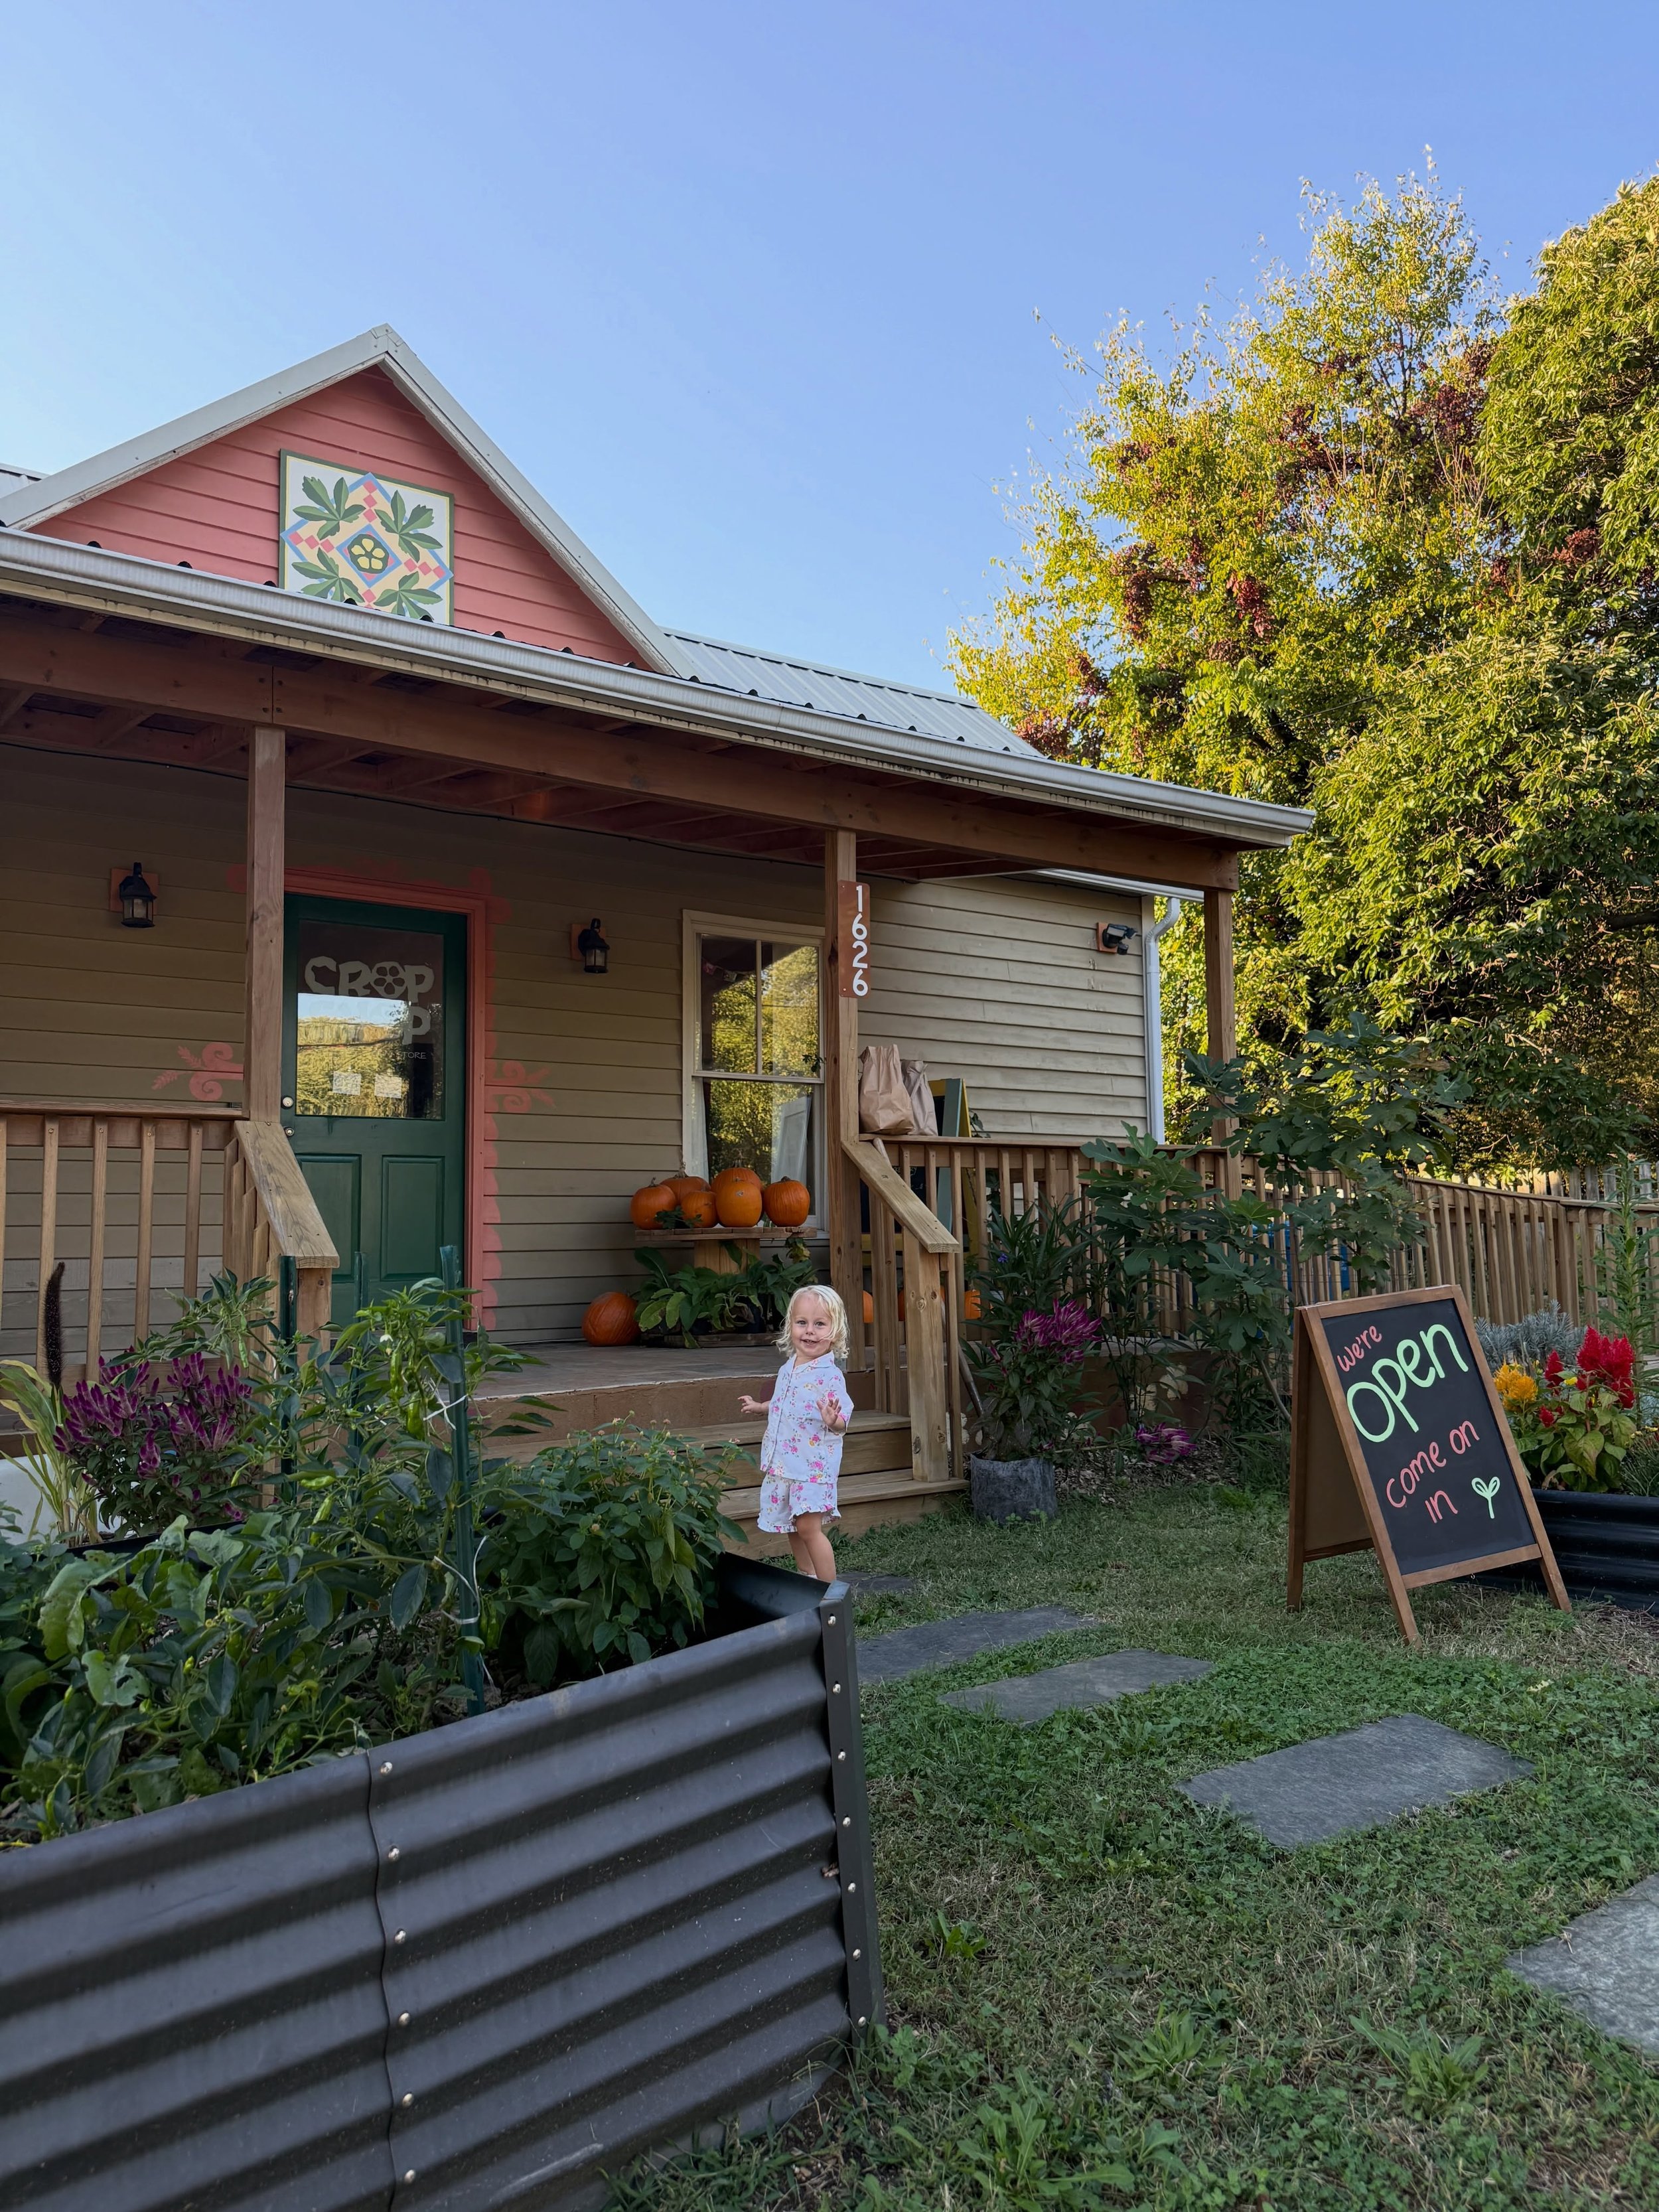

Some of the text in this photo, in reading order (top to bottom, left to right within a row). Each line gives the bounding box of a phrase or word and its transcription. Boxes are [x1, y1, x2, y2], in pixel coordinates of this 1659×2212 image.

[852, 885, 868, 996] 1626
[305, 956, 435, 1003] CROP
[1449, 1420, 1480, 1455] on
